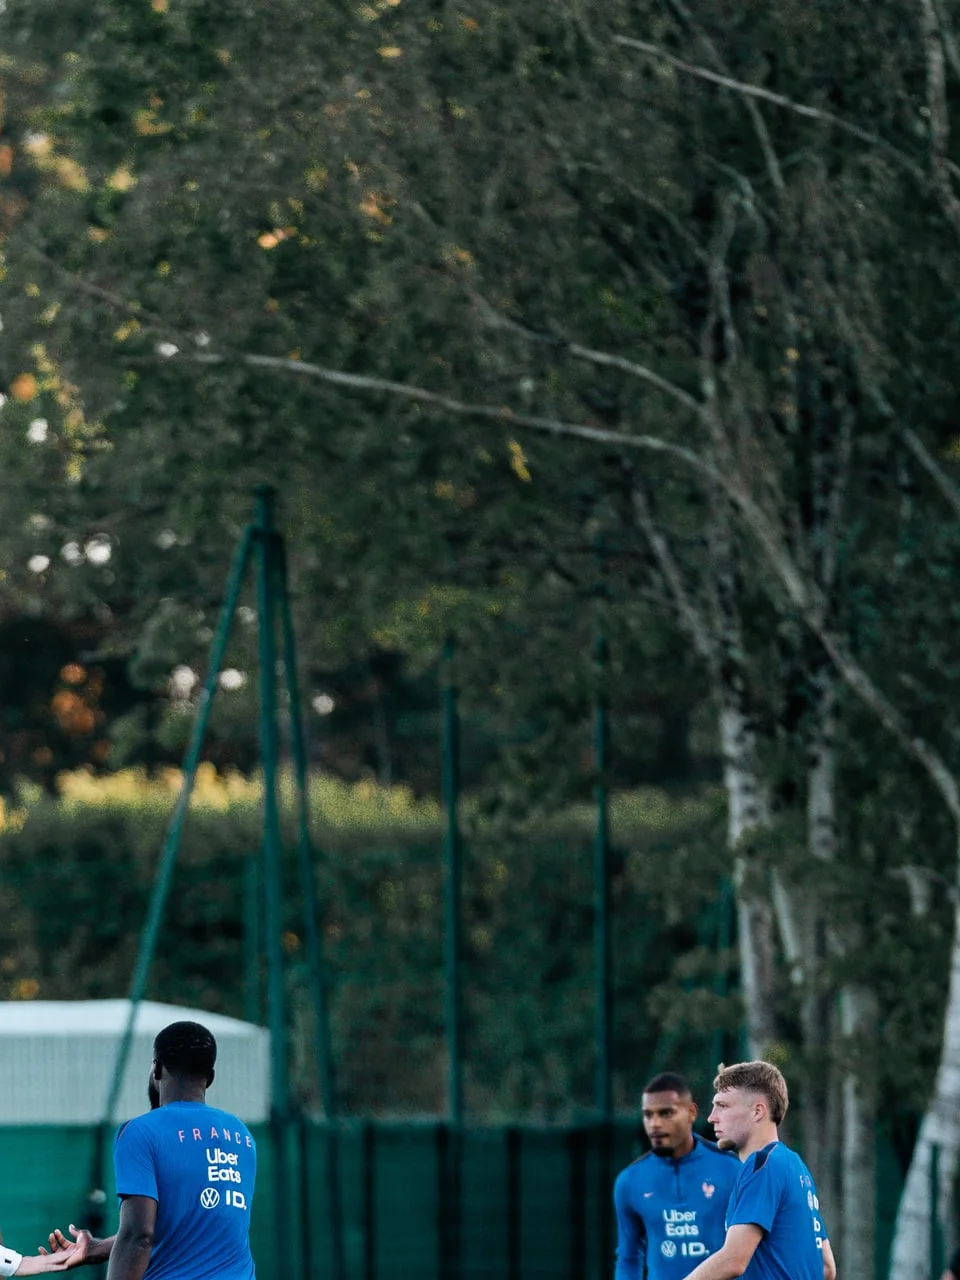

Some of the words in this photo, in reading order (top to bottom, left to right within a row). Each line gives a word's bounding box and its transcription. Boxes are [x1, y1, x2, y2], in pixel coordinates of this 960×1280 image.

[178, 1126, 252, 1148] FRANCE
[206, 1148, 239, 1165] Uber
[208, 1166, 242, 1184] Eats
[663, 1209, 697, 1222] Uber
[665, 1223, 700, 1237] Eats
